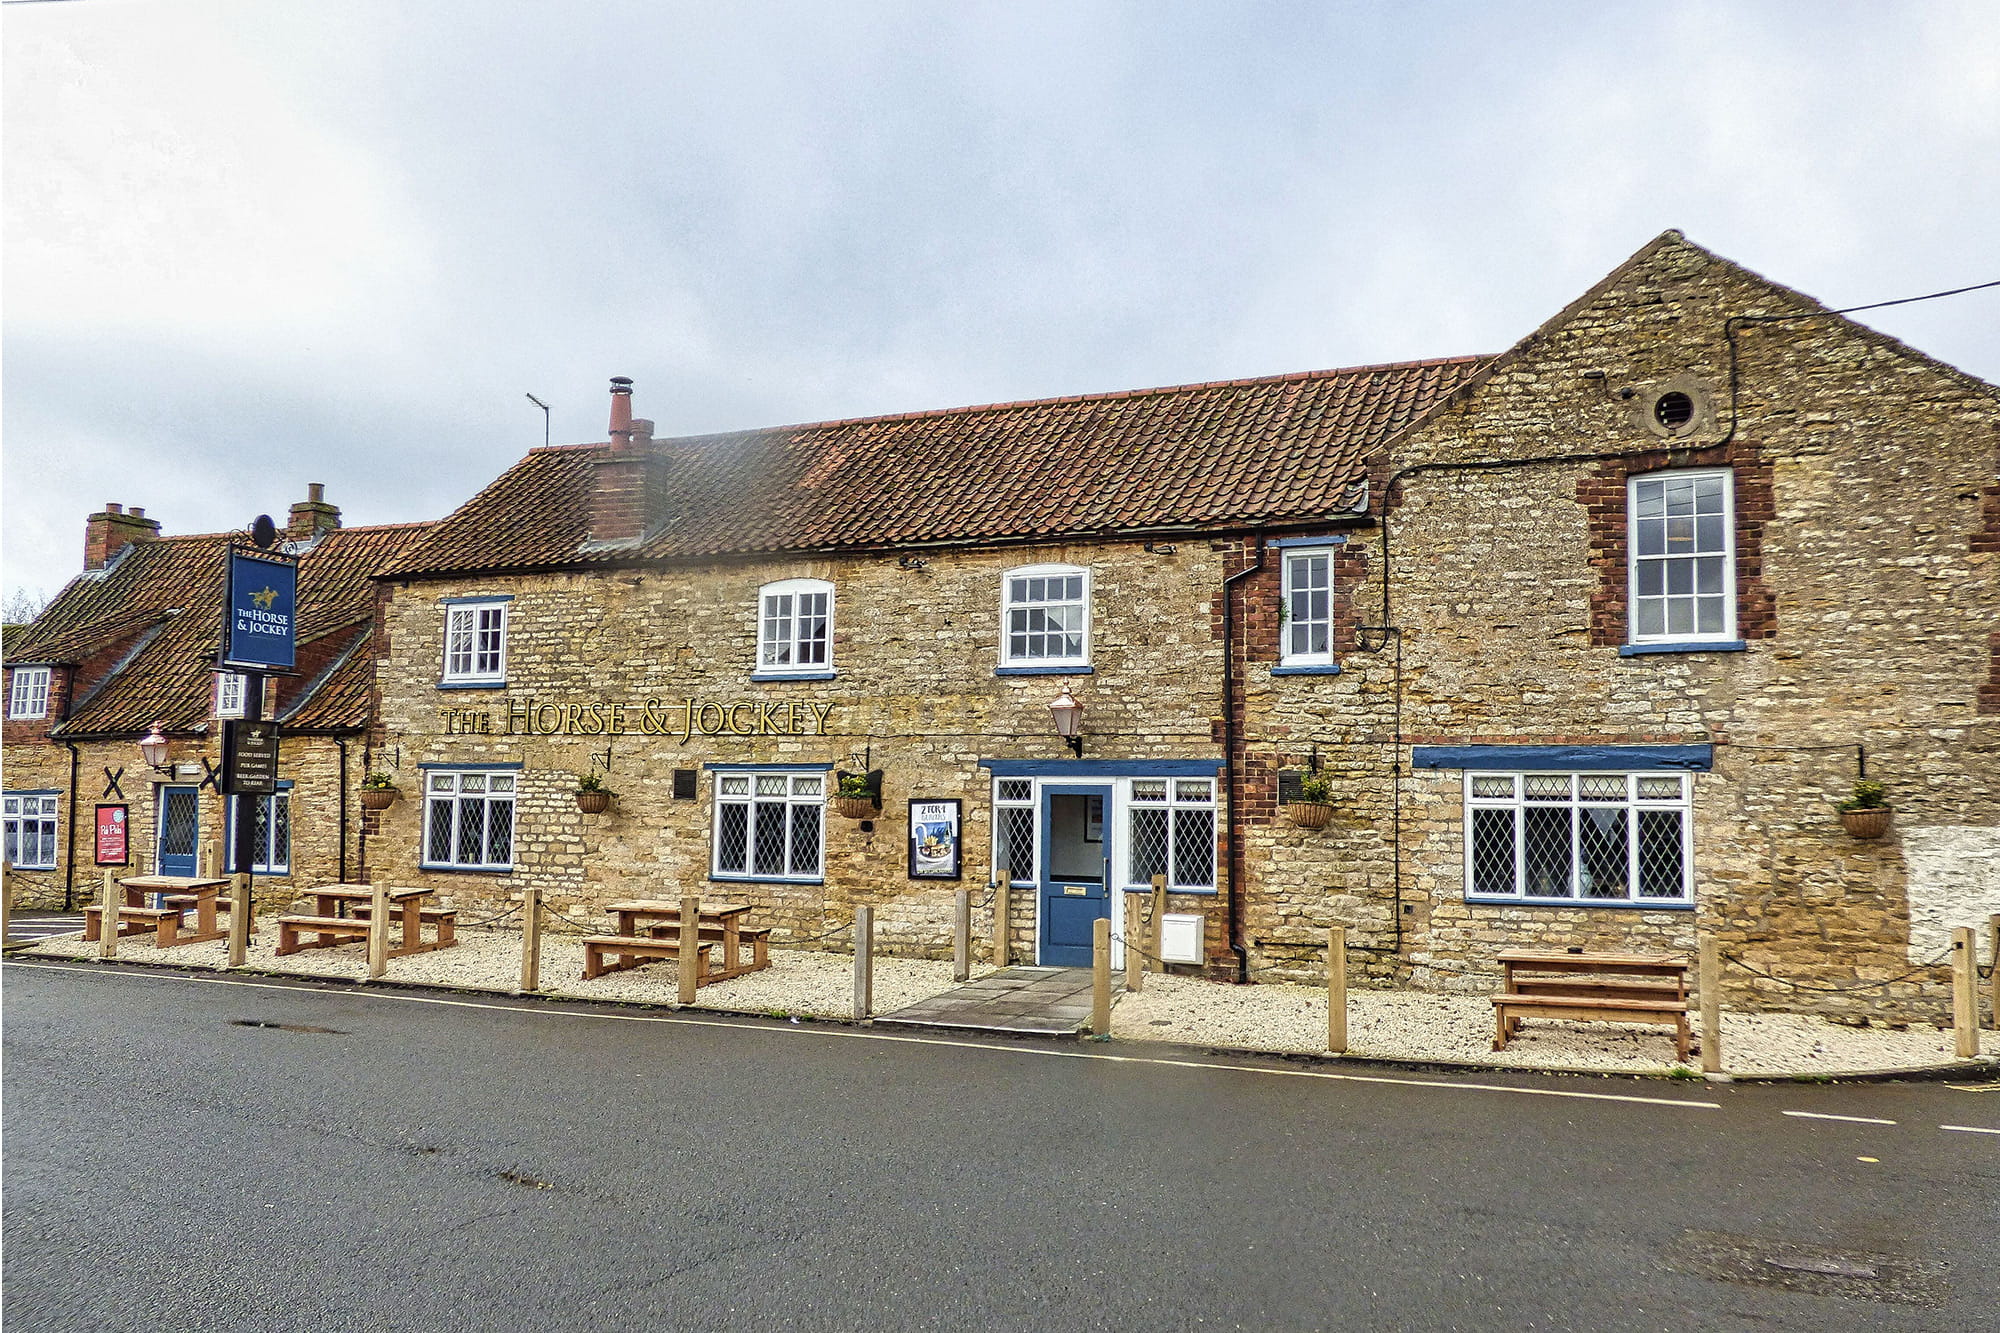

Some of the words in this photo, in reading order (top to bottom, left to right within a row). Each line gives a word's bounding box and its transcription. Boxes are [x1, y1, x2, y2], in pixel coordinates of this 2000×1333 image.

[253, 609, 288, 625] HORSE
[237, 619, 247, 630] &
[249, 620, 288, 636] JOCKEY
[441, 708, 490, 734] THE
[505, 699, 626, 735] HORSE
[639, 698, 671, 735] &
[679, 697, 835, 746] JOCKEY
